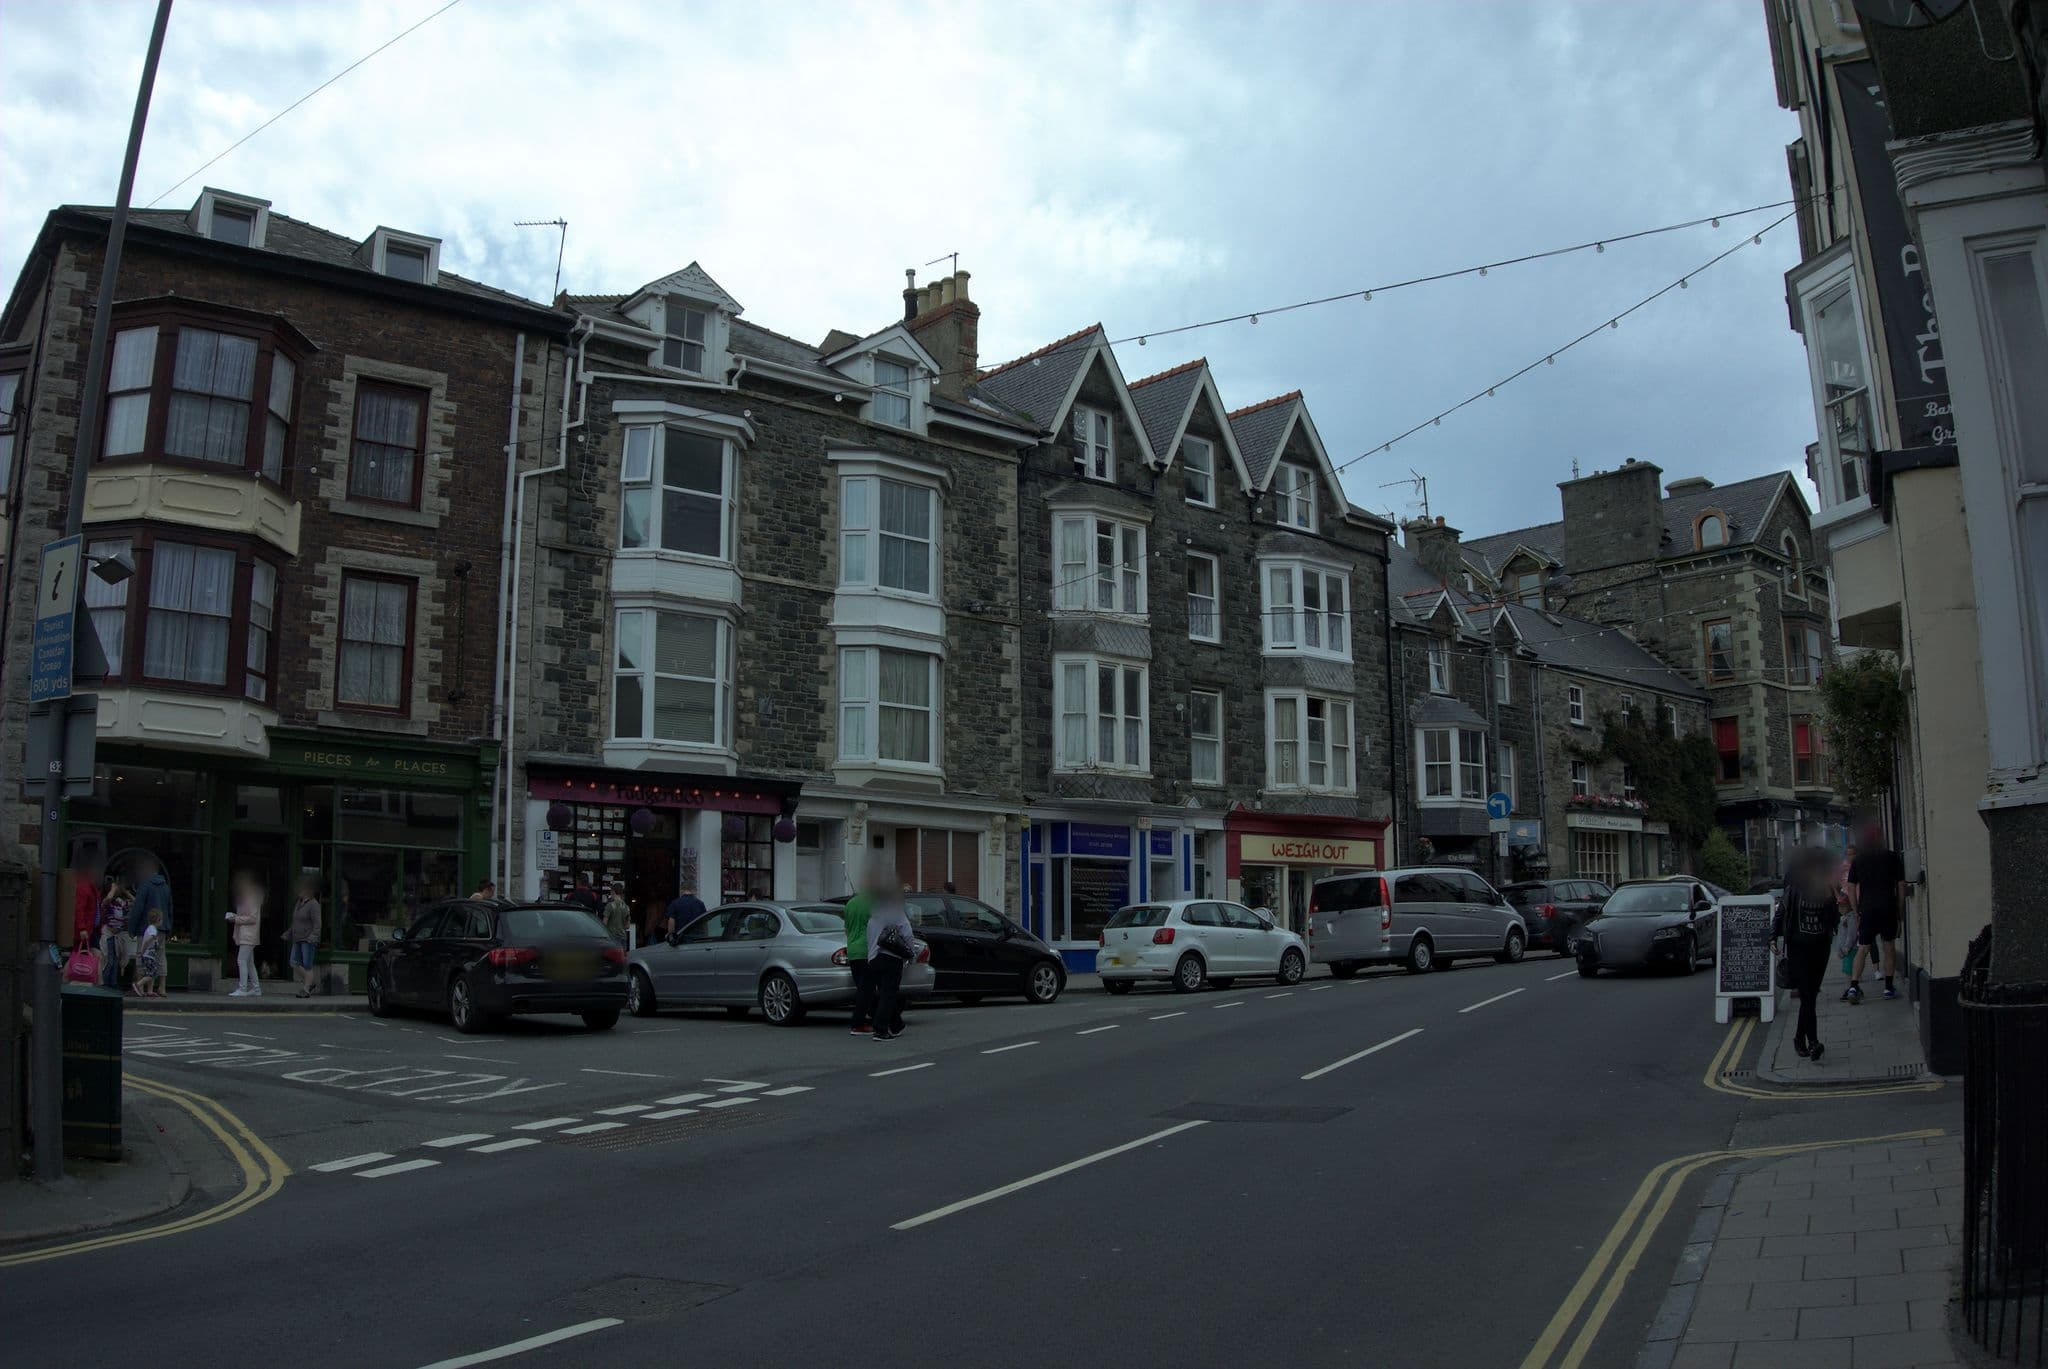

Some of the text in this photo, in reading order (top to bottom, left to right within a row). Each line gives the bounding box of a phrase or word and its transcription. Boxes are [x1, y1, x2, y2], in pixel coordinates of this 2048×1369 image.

[33, 675, 68, 693] 600 yds
[304, 751, 352, 766] PIECES
[394, 759, 448, 774] PLACES
[1272, 842, 1349, 859] WEIGH OUT
